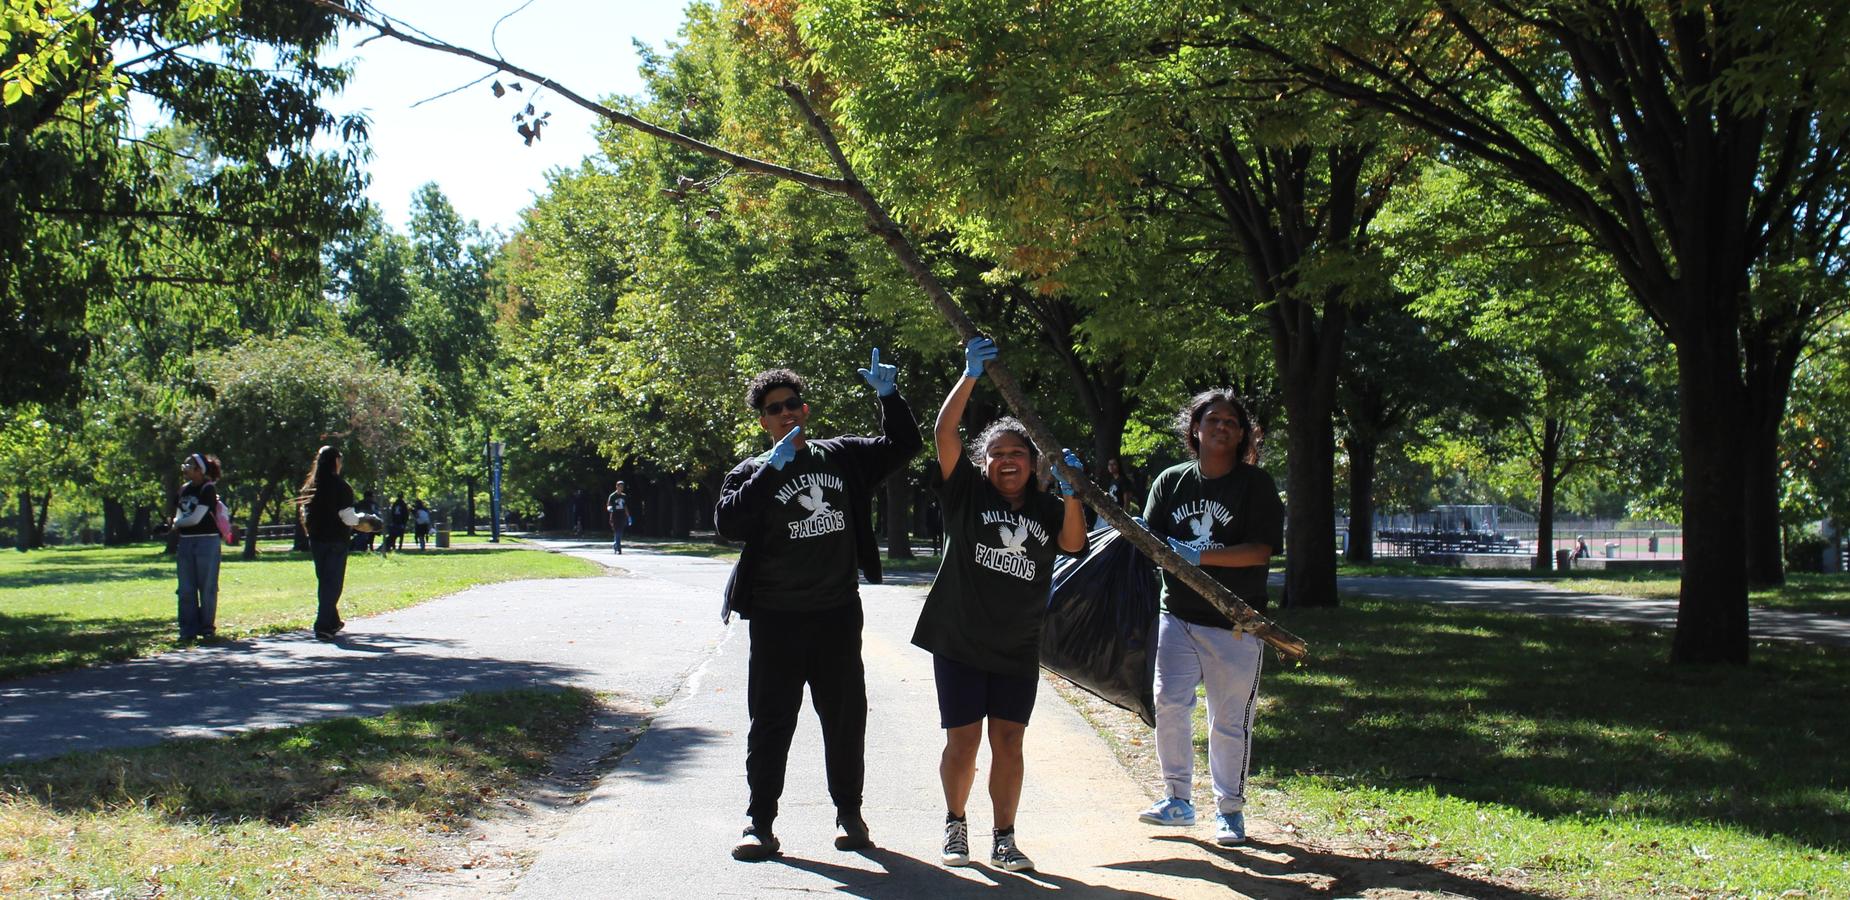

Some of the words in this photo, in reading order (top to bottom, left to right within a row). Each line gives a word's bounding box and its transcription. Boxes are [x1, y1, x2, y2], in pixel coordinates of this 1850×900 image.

[774, 473, 843, 504] MILLENNIUM
[788, 510, 845, 539] FALCONS
[981, 510, 1049, 546] MILLENNIUM
[975, 543, 1036, 581] FALCONS
